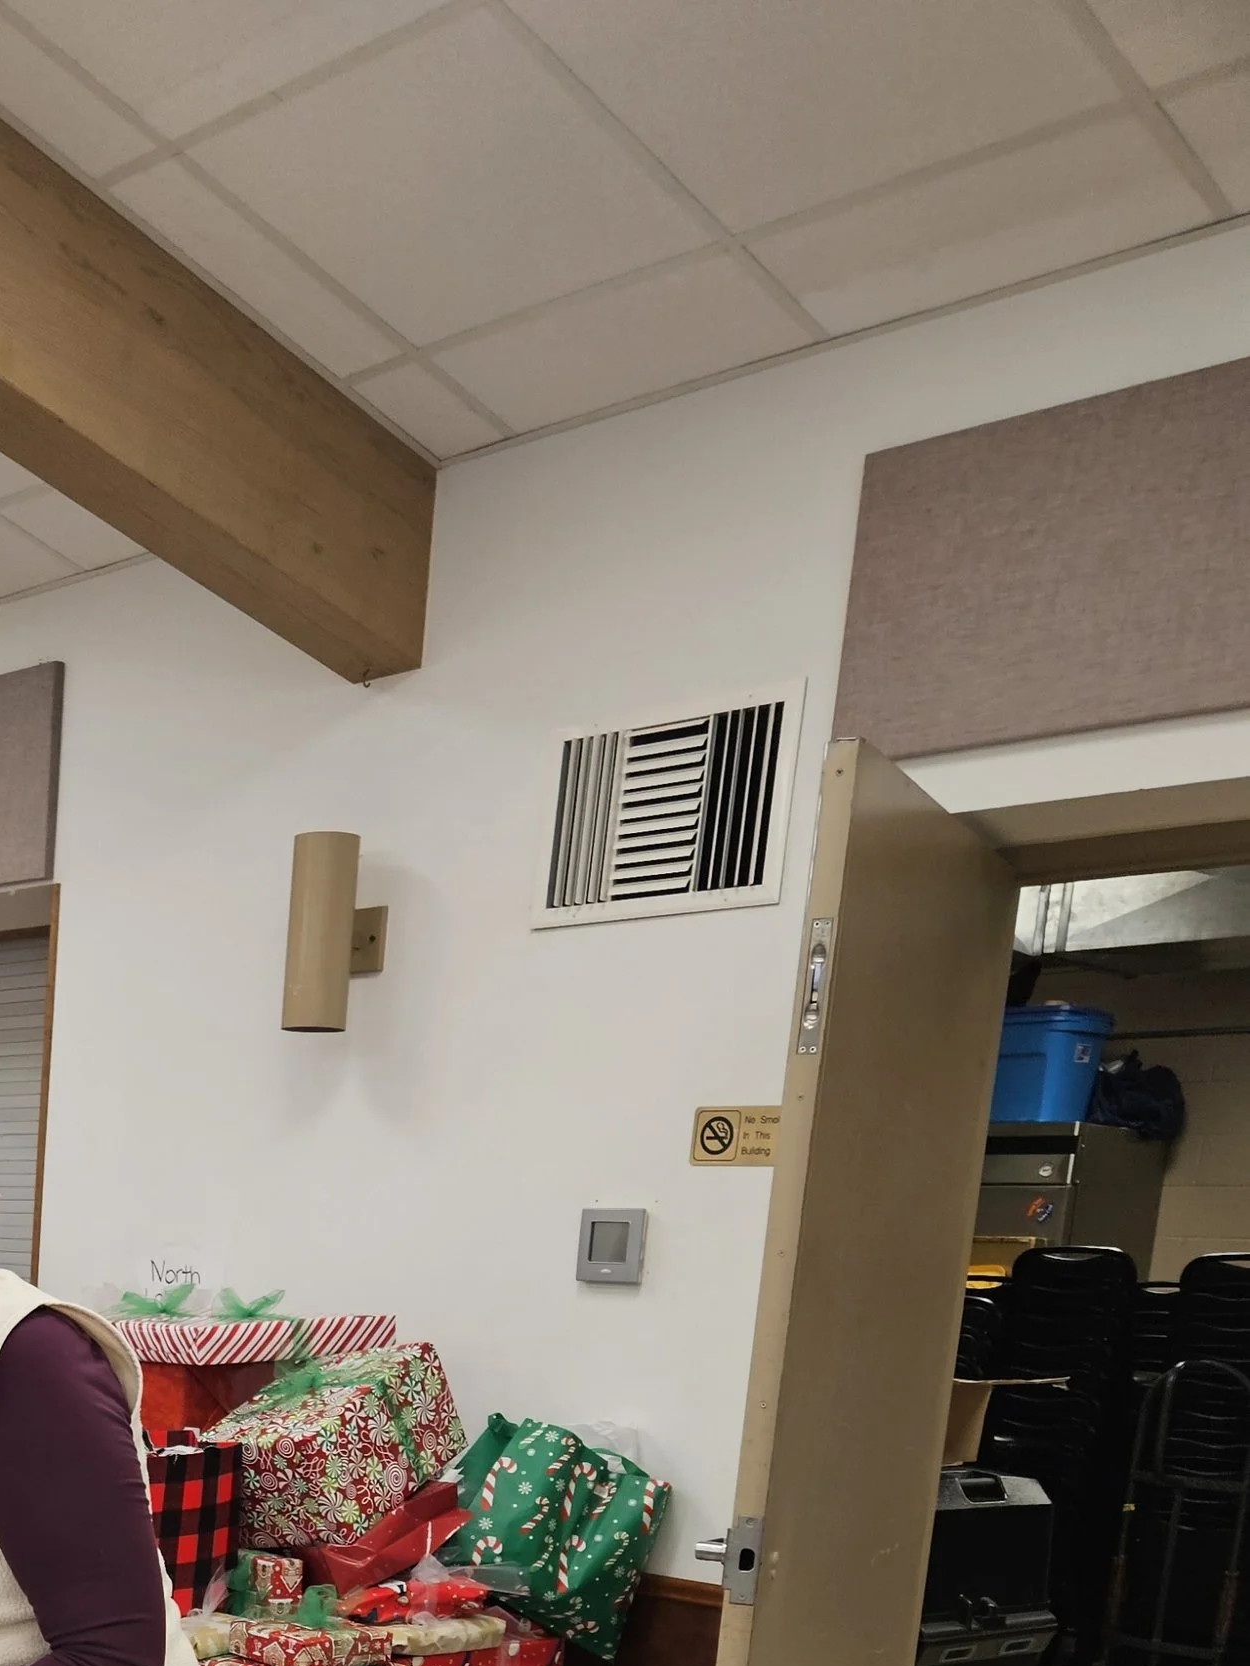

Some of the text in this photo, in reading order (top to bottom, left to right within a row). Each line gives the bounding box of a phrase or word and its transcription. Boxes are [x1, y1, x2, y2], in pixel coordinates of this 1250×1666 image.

[755, 1131, 771, 1140] This
[741, 1146, 771, 1157] Building
[151, 1259, 200, 1286] North
